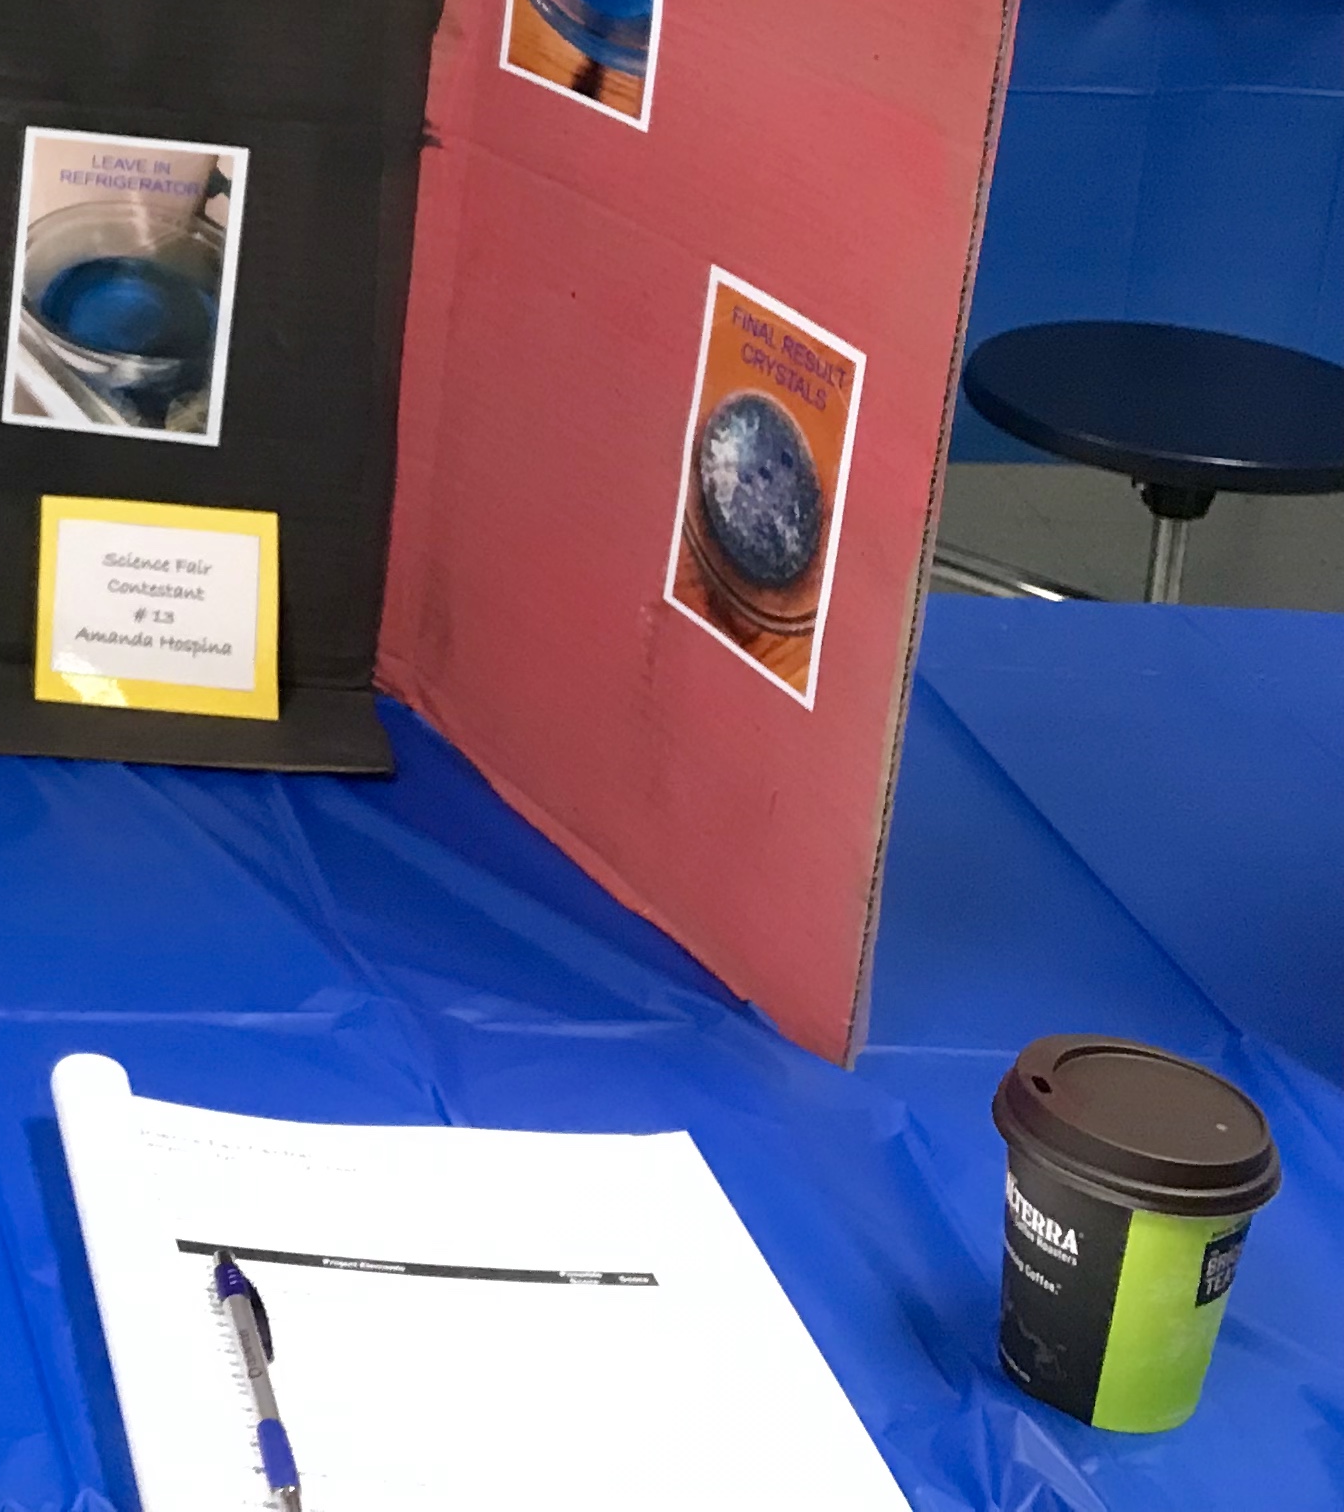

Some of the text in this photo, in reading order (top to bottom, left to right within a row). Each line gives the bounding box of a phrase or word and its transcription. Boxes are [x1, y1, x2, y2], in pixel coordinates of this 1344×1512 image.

[91, 154, 172, 175] LEAVE IN
[60, 168, 200, 196] REFRIGERATOR
[733, 305, 847, 389] FINAL RESULT
[741, 342, 827, 412] CRYSTALS
[102, 552, 213, 575] Science Fair
[107, 577, 206, 601] Contestant
[75, 626, 153, 648] Amanda
